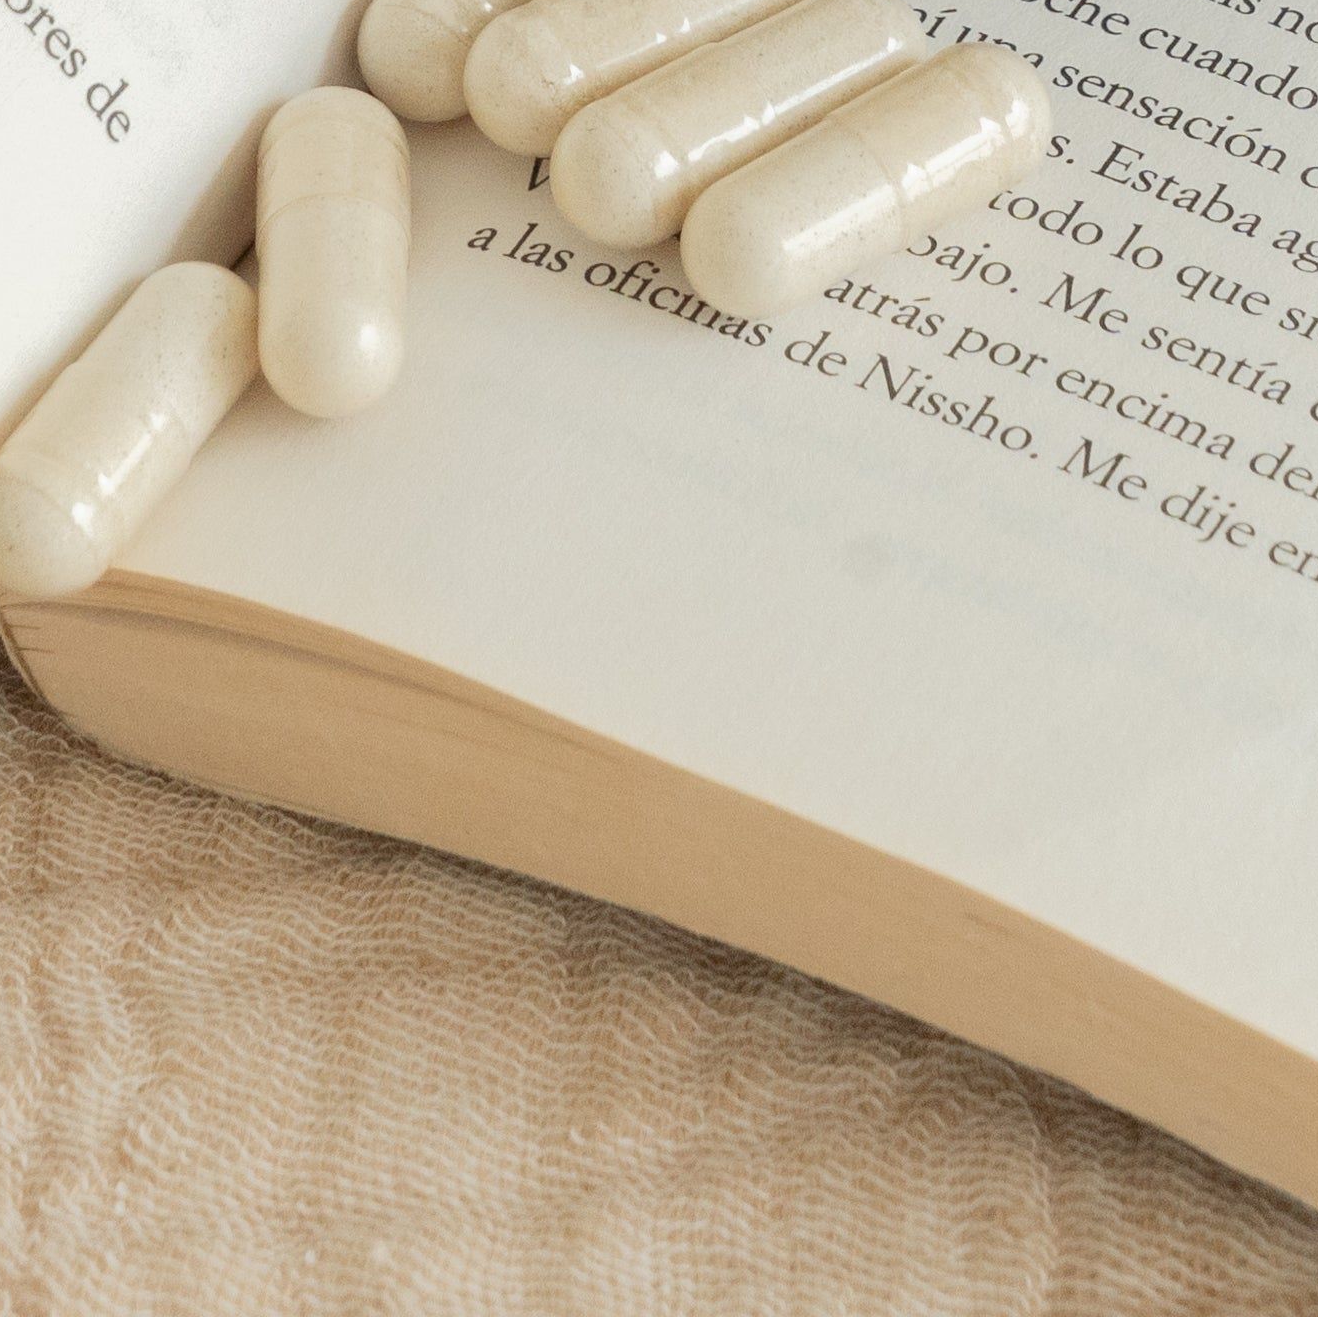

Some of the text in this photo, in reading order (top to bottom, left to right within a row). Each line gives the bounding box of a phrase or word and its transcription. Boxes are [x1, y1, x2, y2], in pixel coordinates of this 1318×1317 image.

[84, 77, 132, 145] de
[782, 329, 849, 378] de
[855, 352, 1039, 461] Nissho.
[1058, 436, 1149, 502] Me
[1158, 484, 1257, 549] dije
